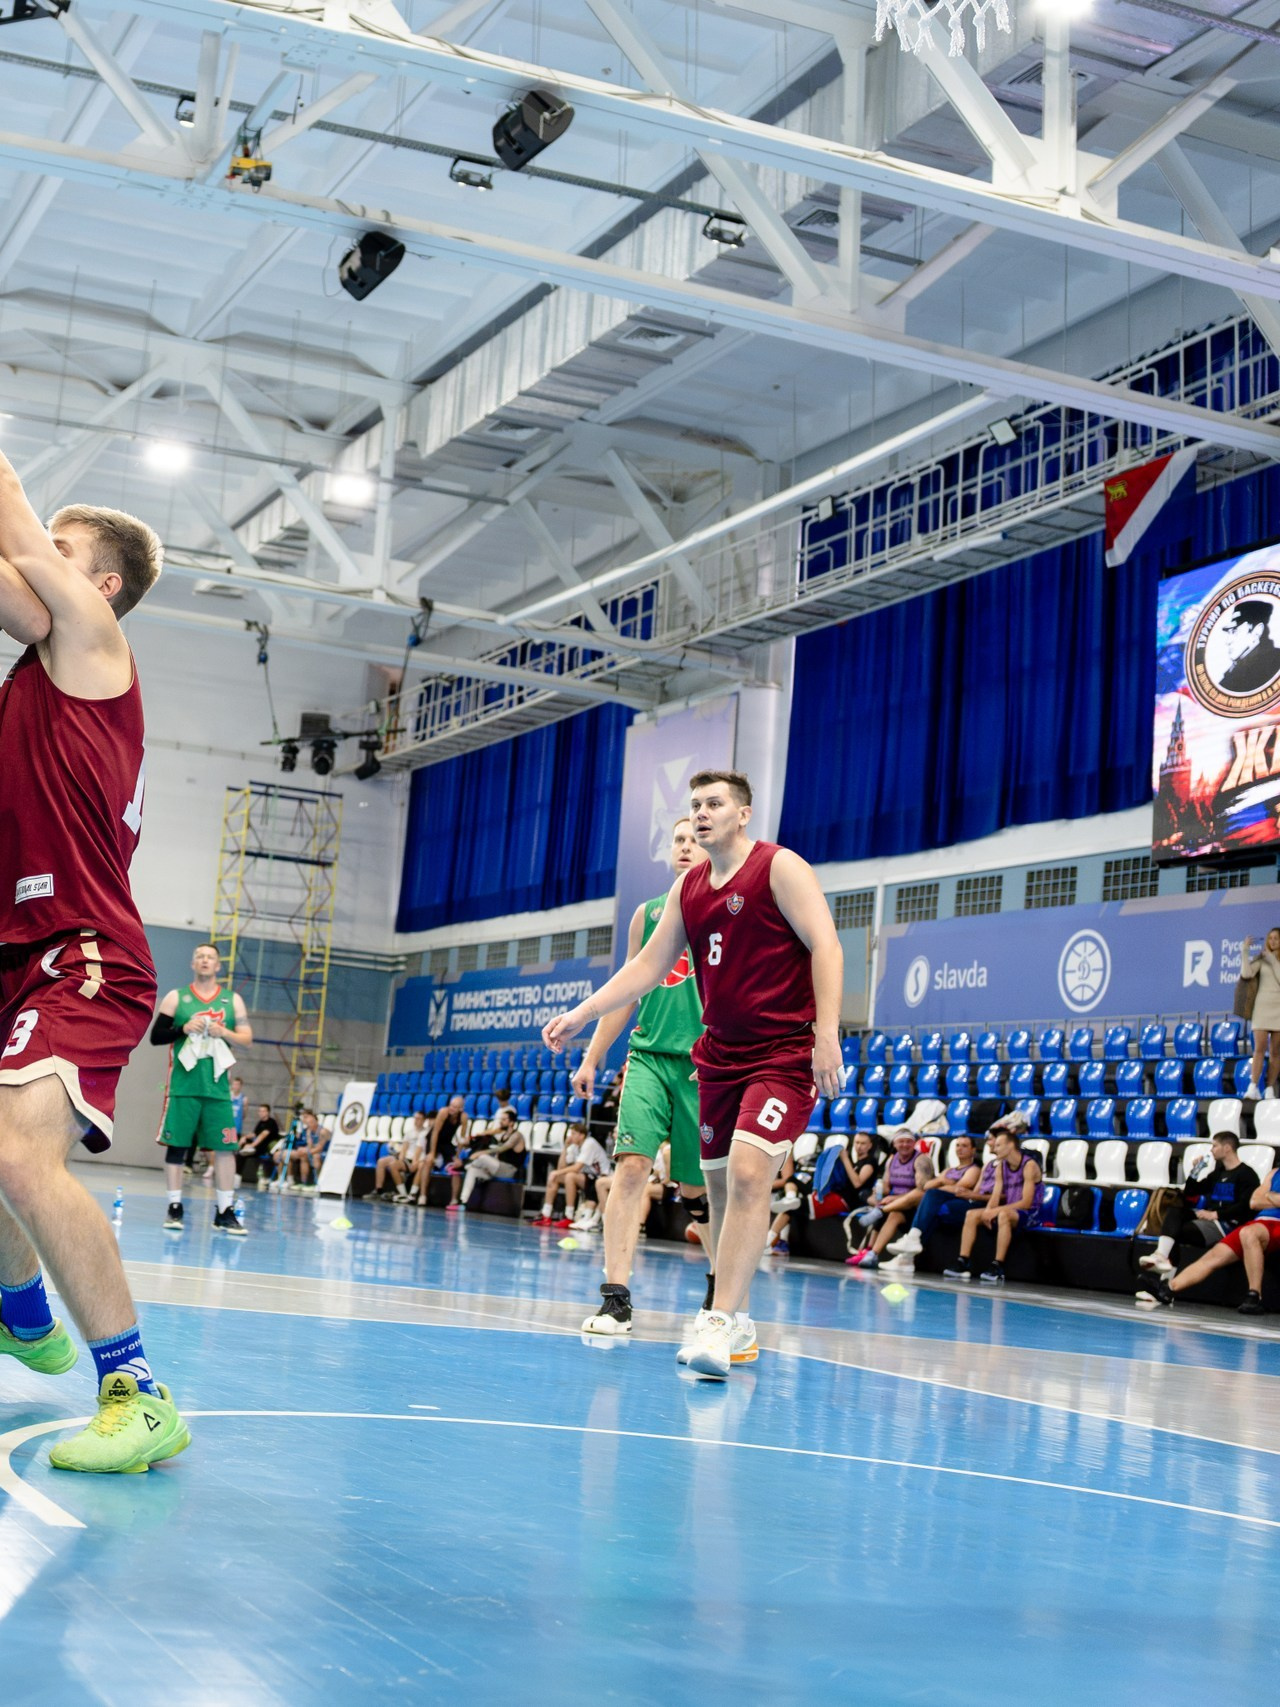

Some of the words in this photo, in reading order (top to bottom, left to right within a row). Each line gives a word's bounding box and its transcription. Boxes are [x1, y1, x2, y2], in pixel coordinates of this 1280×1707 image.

[1236, 580, 1280, 599] БАСКЕТБ
[1220, 724, 1280, 793] Ж
[708, 932, 723, 966] 6
[933, 959, 988, 991] slavda
[452, 984, 542, 1010] МИНИСТЕРСТВО
[543, 980, 593, 1004] СПОРТА
[450, 1009, 532, 1032] ПРИМОРСКОГО
[757, 1097, 788, 1131] 6
[108, 1388, 131, 1397] PEAK
